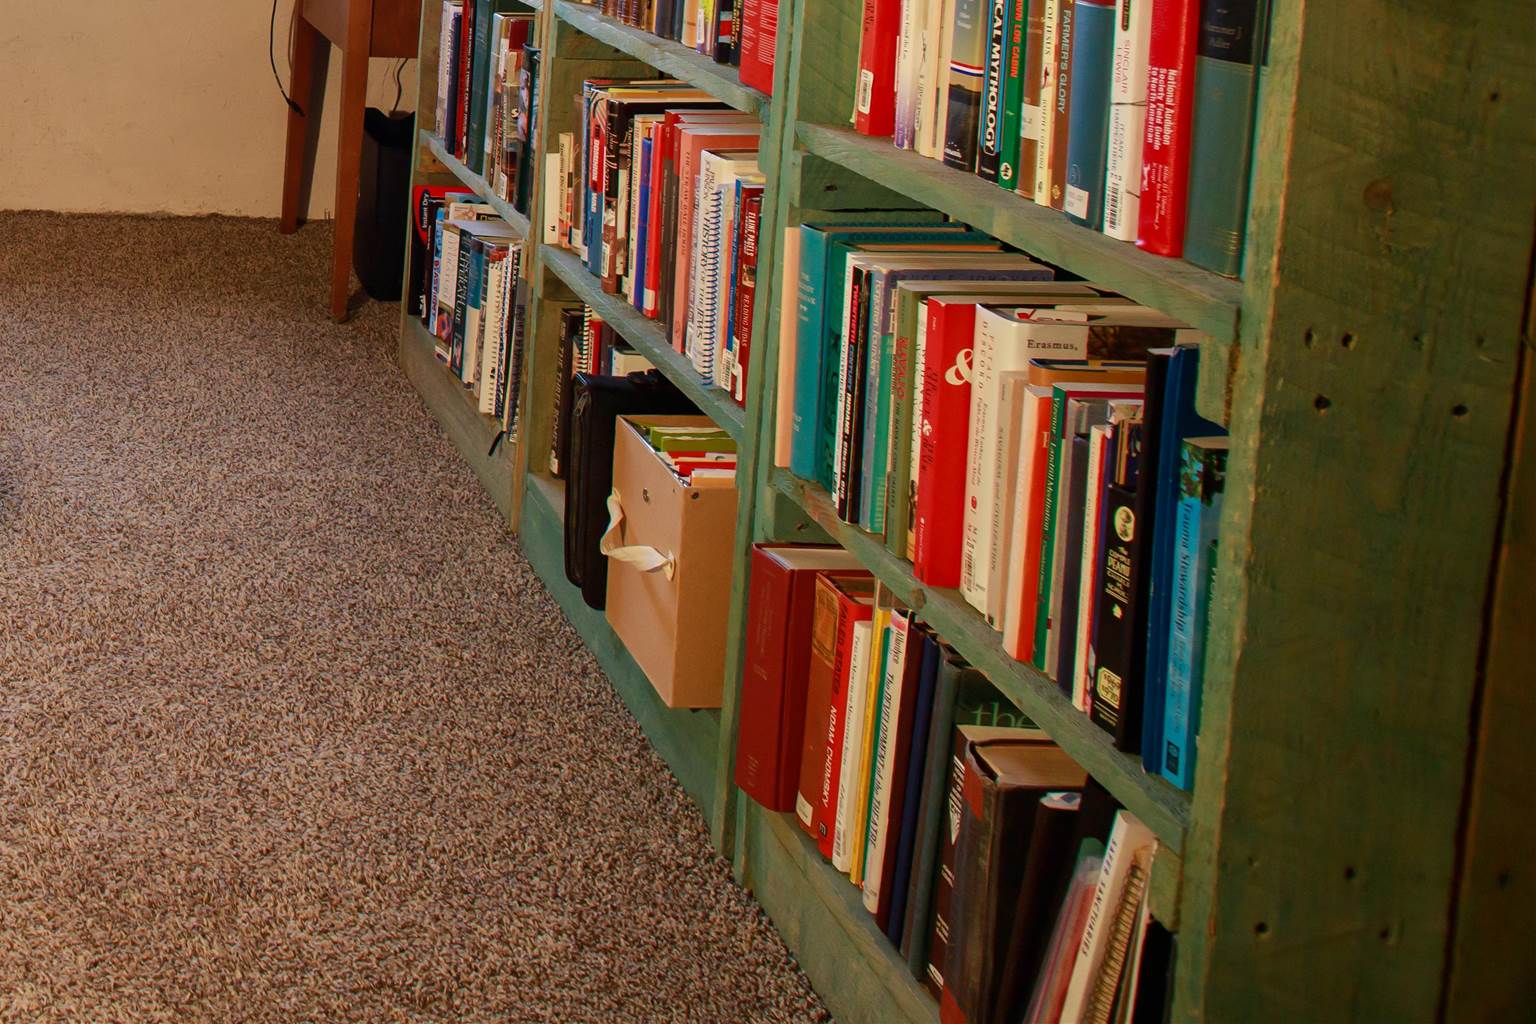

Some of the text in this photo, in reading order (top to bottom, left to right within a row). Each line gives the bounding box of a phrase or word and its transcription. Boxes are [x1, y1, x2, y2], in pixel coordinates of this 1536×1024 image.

[1013, 23, 1022, 43] LOG
[1043, 24, 1052, 55] JESUS
[1046, 6, 1054, 21] OF
[1060, 8, 1072, 71] FARMER'S
[1010, 45, 1020, 78] CABIN
[1111, 47, 1125, 83] LEWIS
[1114, 39, 1136, 94] SINCLAIR
[981, 41, 1005, 150] MYTHOLOGY
[1057, 73, 1067, 113] GLORY
[1146, 66, 1160, 143] to North American
[1153, 67, 1168, 151] Society Field Guide
[1162, 68, 1177, 146] National Audubon
[700, 216, 710, 270] HISTORY
[745, 210, 756, 258] ELAINE PAGELS
[694, 306, 705, 341] JEWS
[740, 292, 750, 348] READING JUDAS
[868, 278, 884, 376] Forgotten Founders
[976, 321, 990, 389] DISCORD
[983, 334, 995, 384] FATAL
[554, 370, 562, 406] THREE
[843, 392, 851, 436] INDIANS
[1042, 396, 1060, 531] Vizenor Landfill Meditation
[990, 502, 999, 572] CIVILIZATION
[1172, 501, 1193, 633] Trauma Stewardship
[837, 603, 848, 646] FAILED
[886, 671, 894, 691] The
[820, 704, 837, 807] NOAM CHOMSKY
[876, 693, 892, 772] DEVELOPMENT
[873, 780, 882, 796] the
[866, 796, 883, 848] THEATRE
[1080, 837, 1118, 958] SAFER SANCTUARIES
